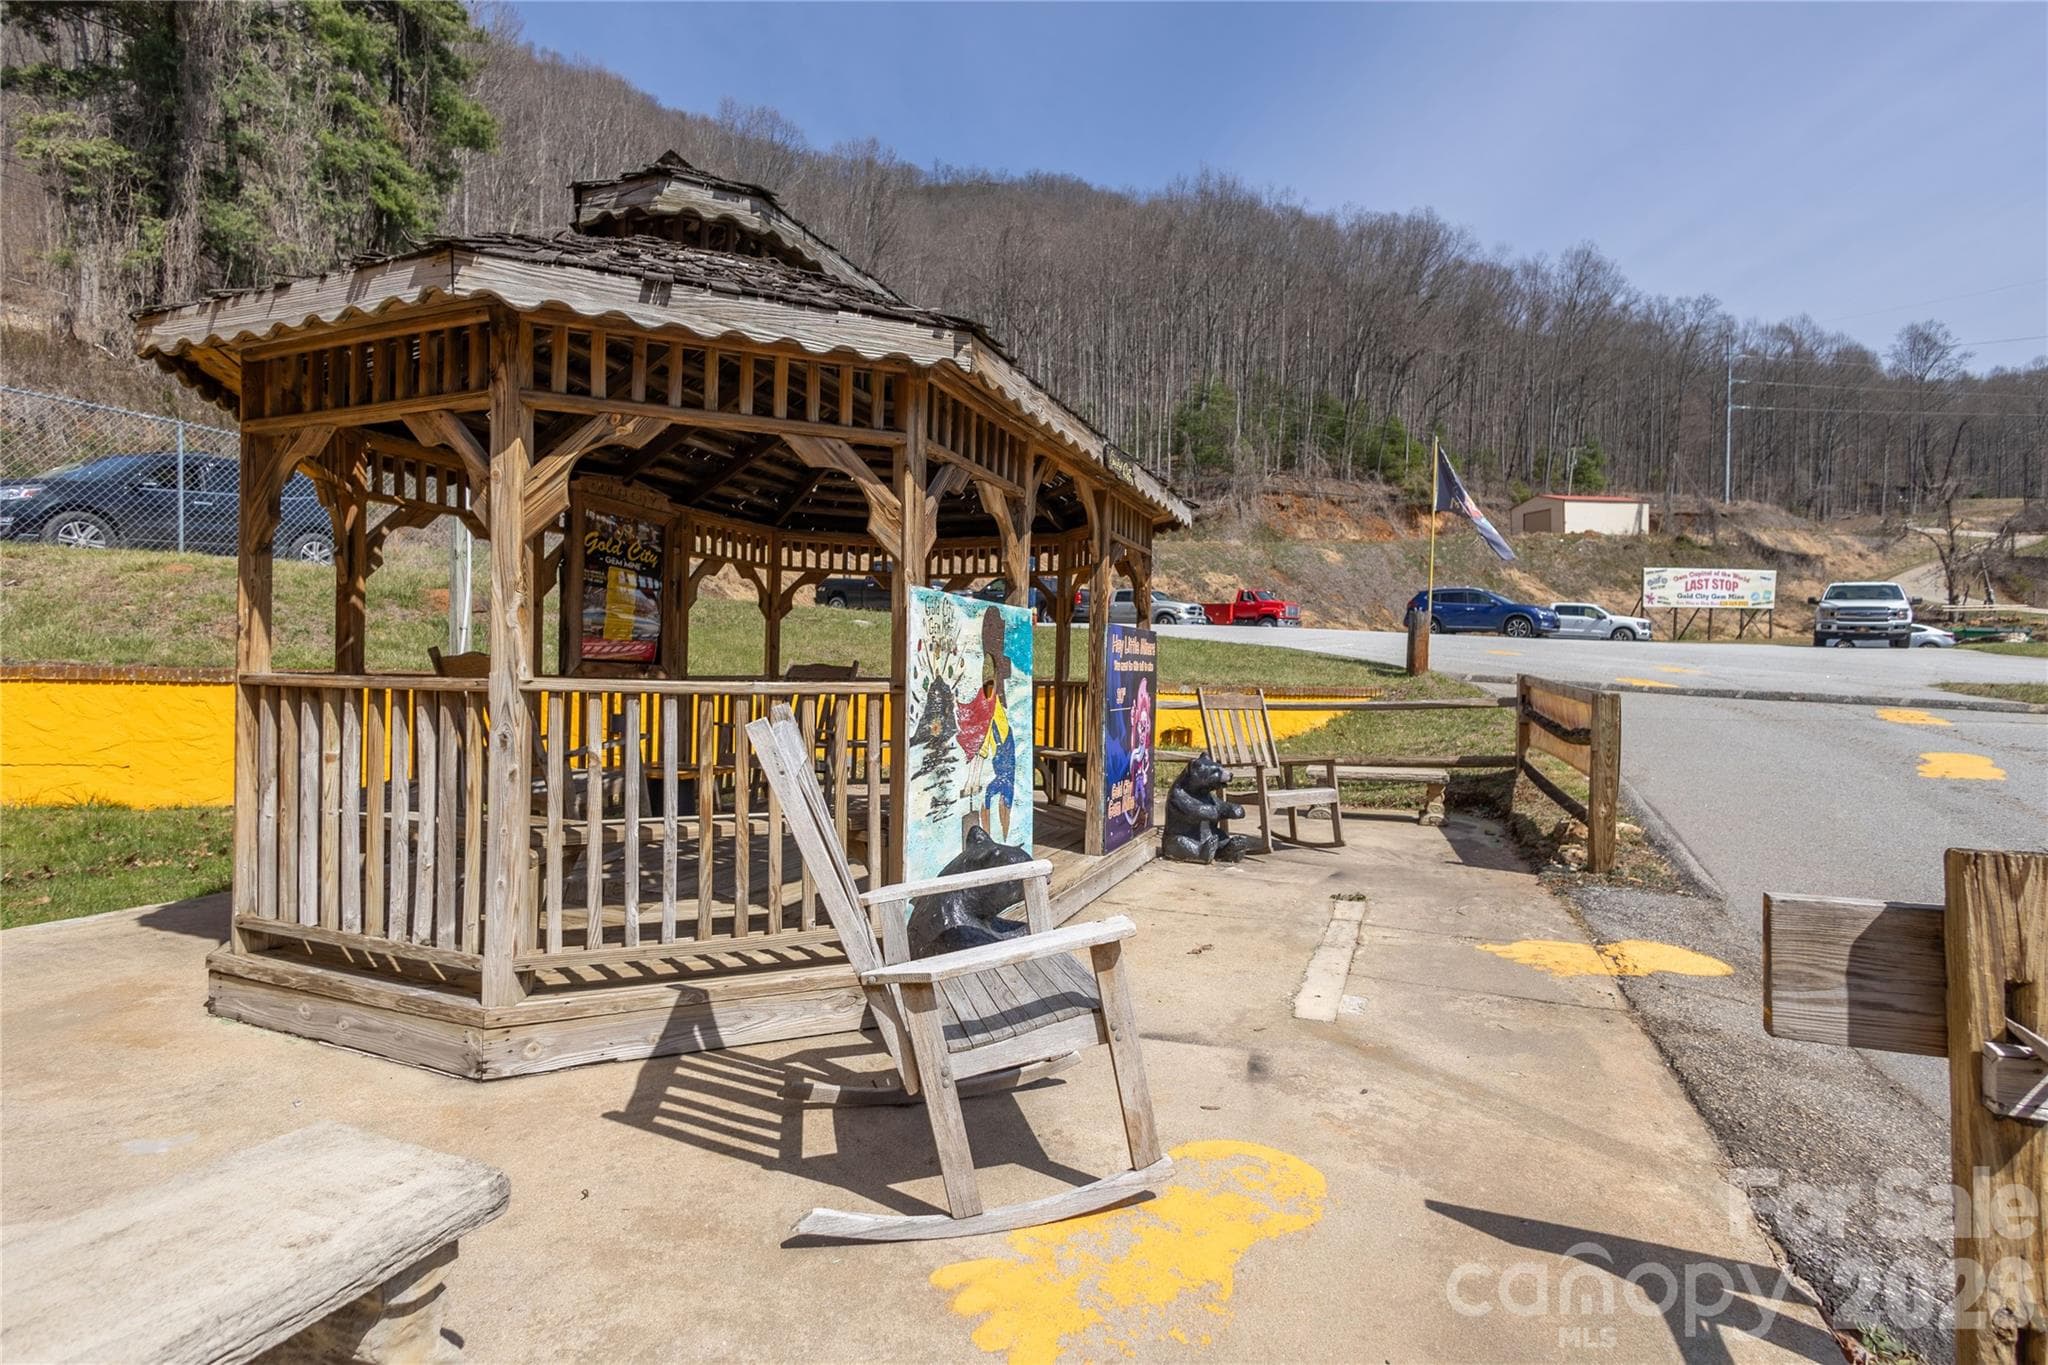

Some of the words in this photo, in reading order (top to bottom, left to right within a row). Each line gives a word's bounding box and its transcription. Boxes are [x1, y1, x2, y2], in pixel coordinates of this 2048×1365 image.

[584, 529, 622, 555] Gold
[627, 538, 658, 568] City
[605, 556, 623, 566] GEM
[623, 558, 641, 570] MINE
[1684, 578, 1710, 592] LAST
[1711, 578, 1739, 592] STOP
[1112, 634, 1124, 658] Hey
[1124, 635, 1140, 655] Little
[1111, 781, 1123, 800] Gold
